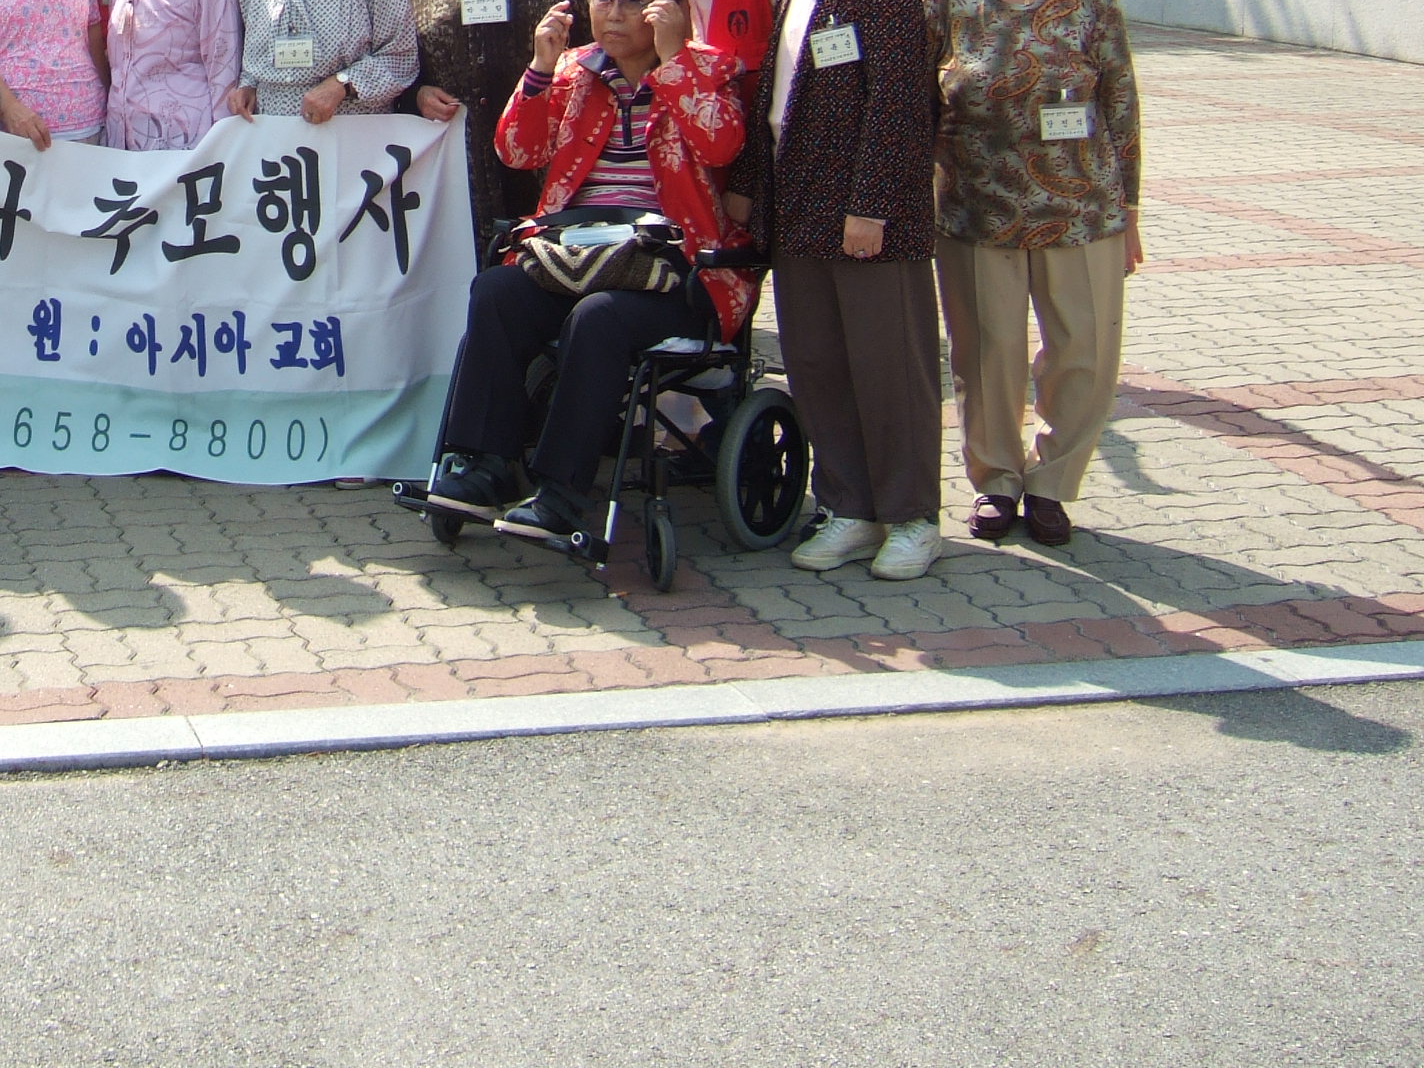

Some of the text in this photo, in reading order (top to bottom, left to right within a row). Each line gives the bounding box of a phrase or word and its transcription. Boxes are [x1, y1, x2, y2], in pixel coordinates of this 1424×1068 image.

[80, 143, 421, 282] 추모행사
[125, 310, 252, 378] 아시아
[269, 315, 346, 378] 교회
